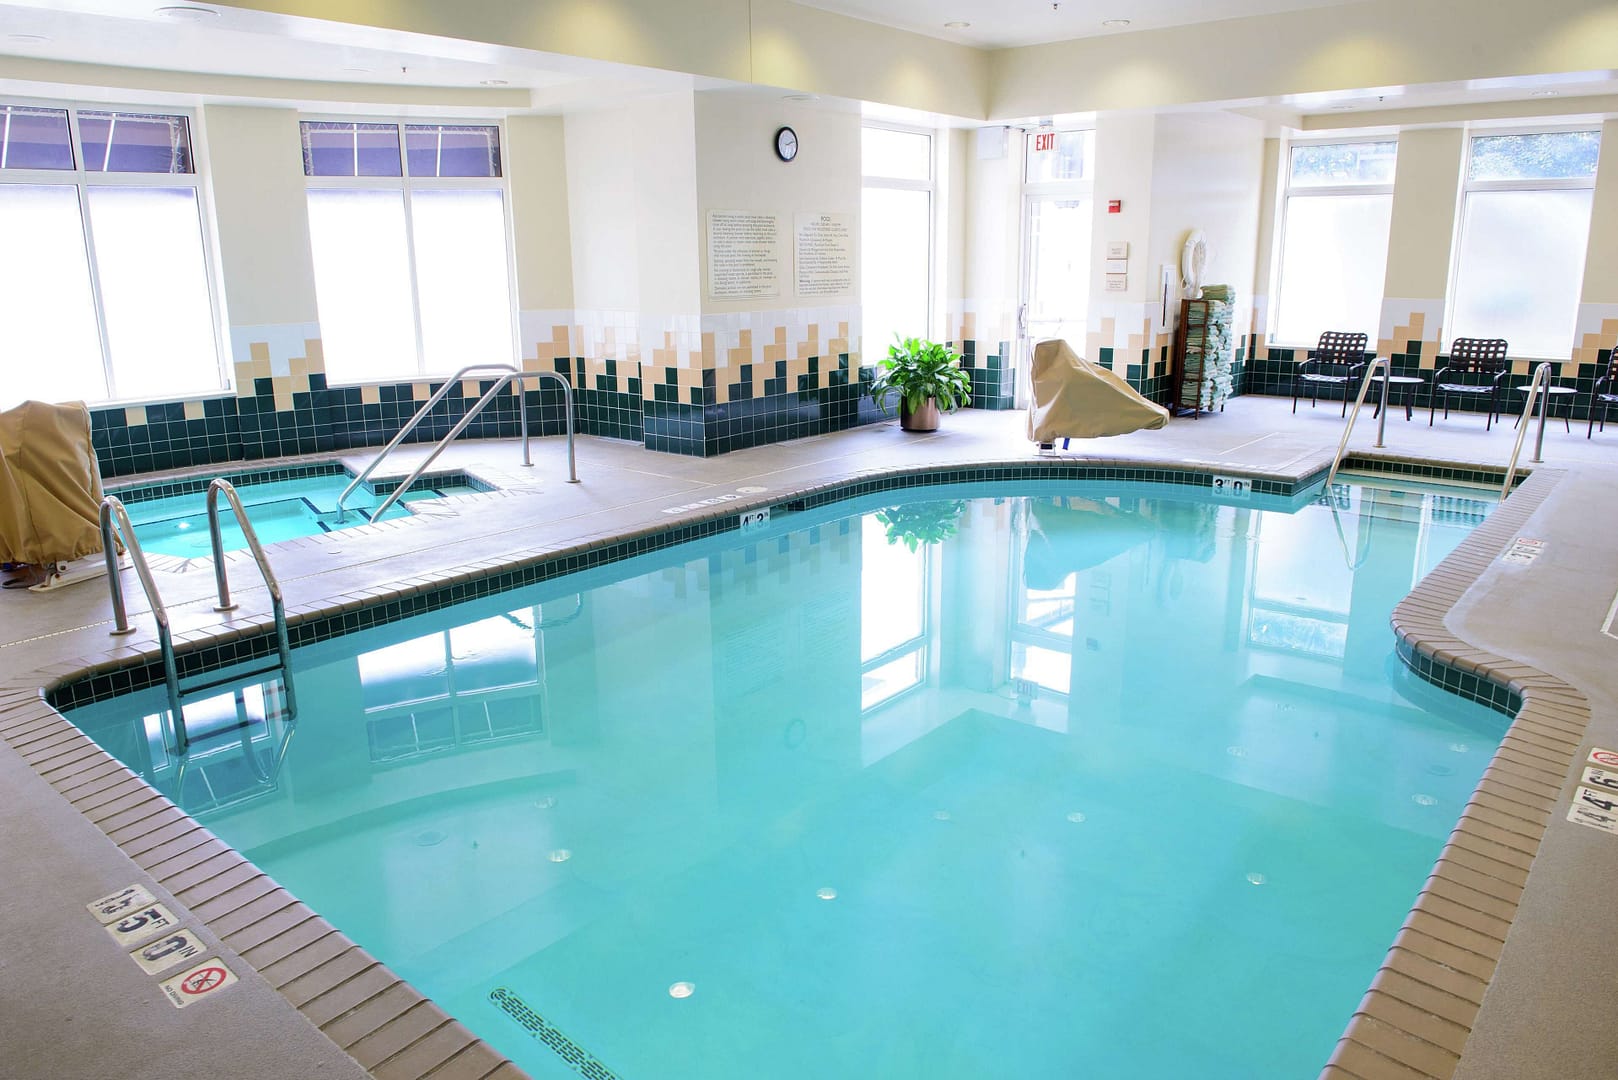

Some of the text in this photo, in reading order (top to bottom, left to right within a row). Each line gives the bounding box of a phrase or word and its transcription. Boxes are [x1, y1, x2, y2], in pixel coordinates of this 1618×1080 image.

[1036, 134, 1055, 151] EXIT
[1582, 795, 1618, 811] 4
[117, 908, 170, 933] 5 FT
[142, 935, 198, 961] 0 IN
